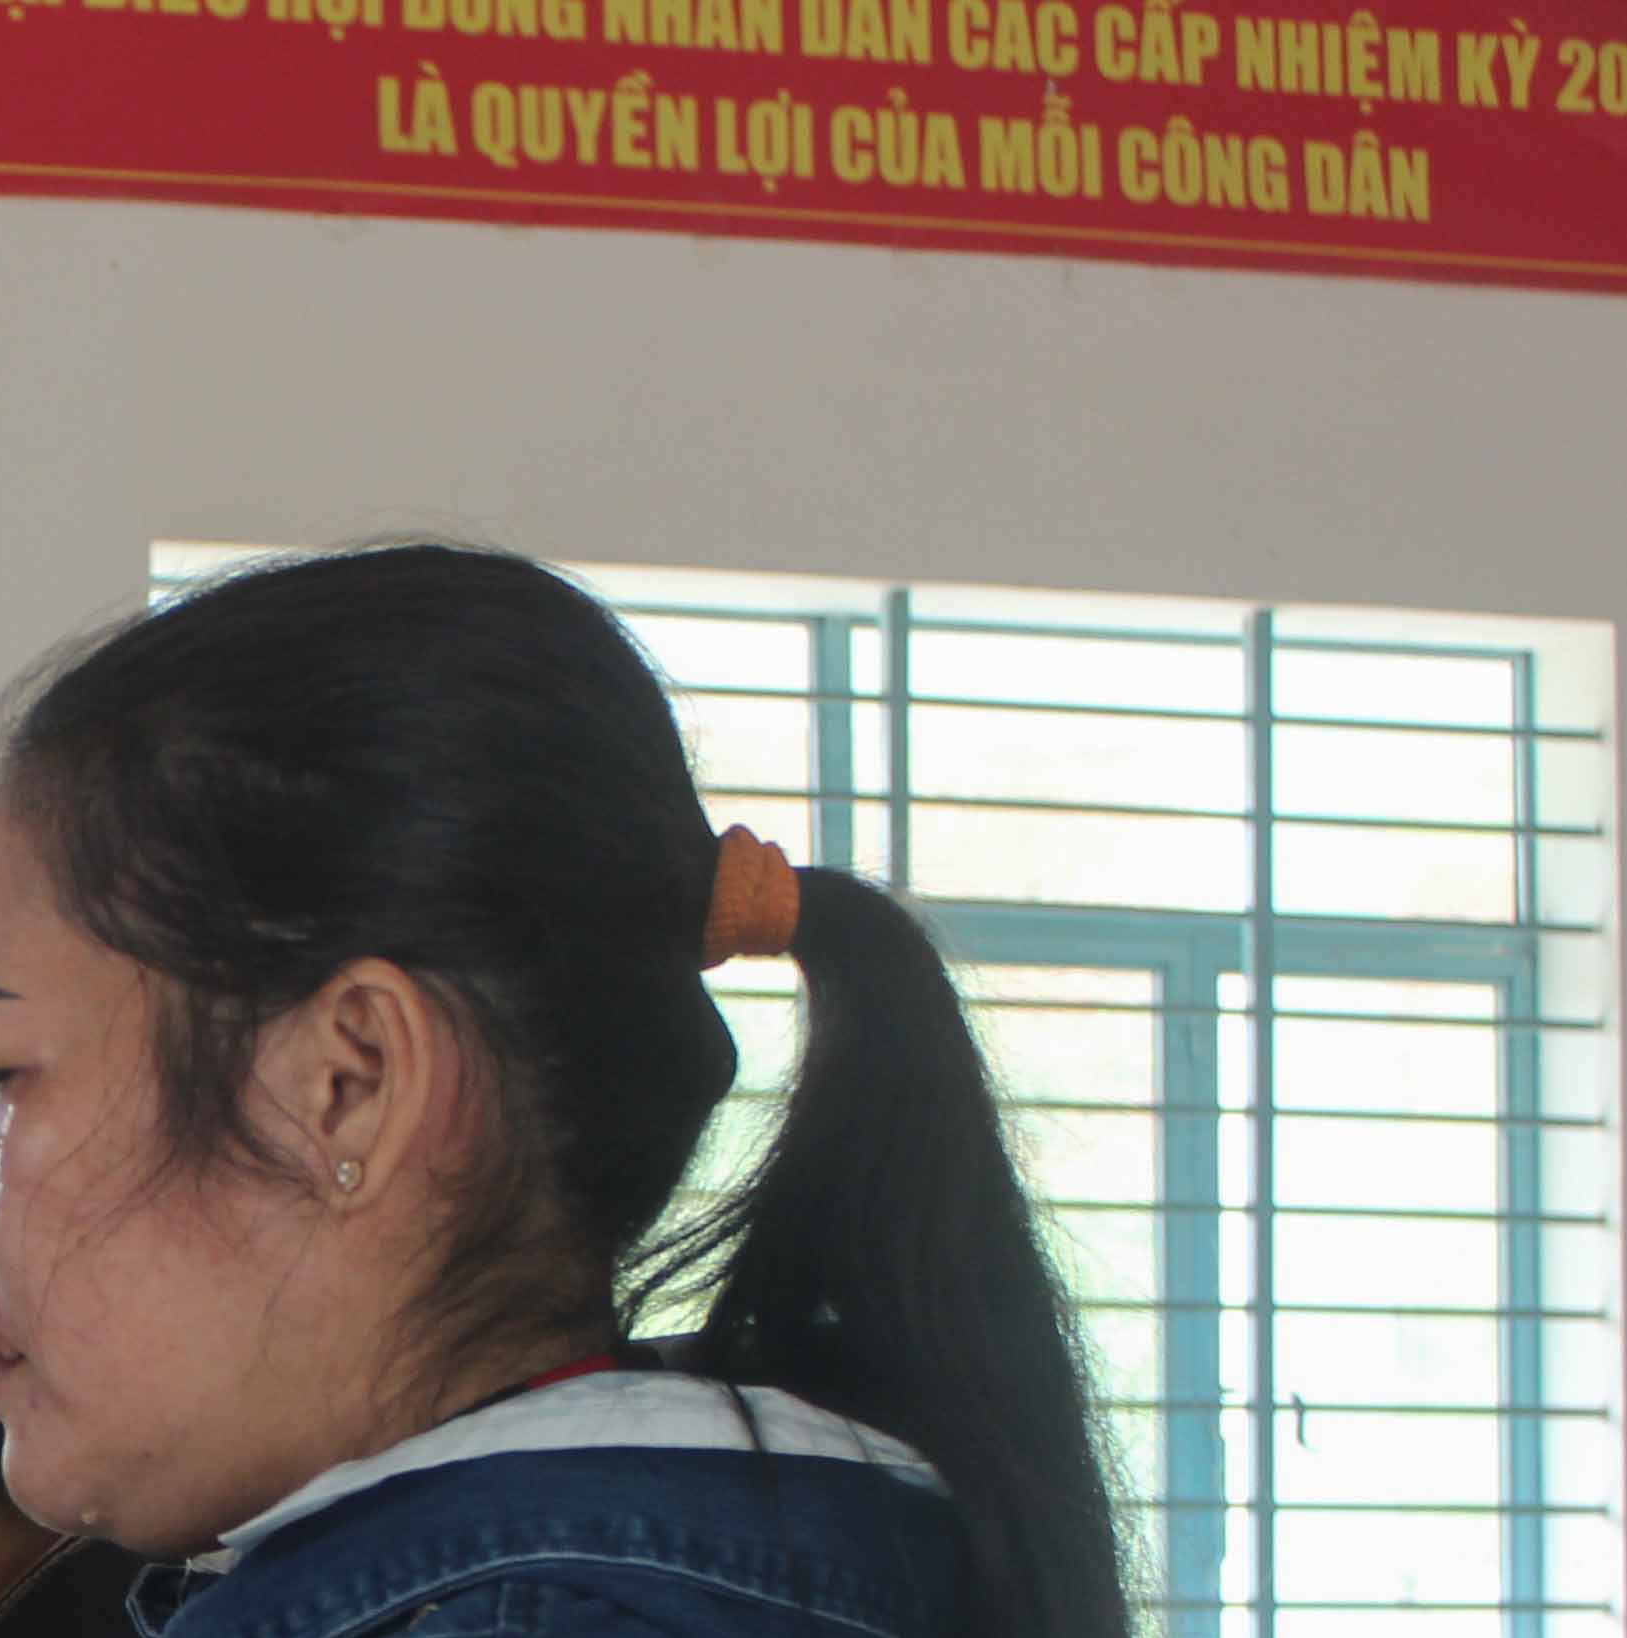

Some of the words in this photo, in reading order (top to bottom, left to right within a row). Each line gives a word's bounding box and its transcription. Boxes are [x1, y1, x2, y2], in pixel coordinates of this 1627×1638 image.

[1235, 11, 1441, 113] NHIỆM
[1457, 19, 1540, 109] KỲ
[378, 61, 457, 156] LÀ
[472, 70, 699, 174] QUYỀN
[716, 88, 815, 193] LỢI
[830, 88, 965, 189] CỦA
[979, 94, 1102, 198] MỖI
[1118, 116, 1289, 214] CÔNG
[1304, 131, 1431, 222] DÂN
